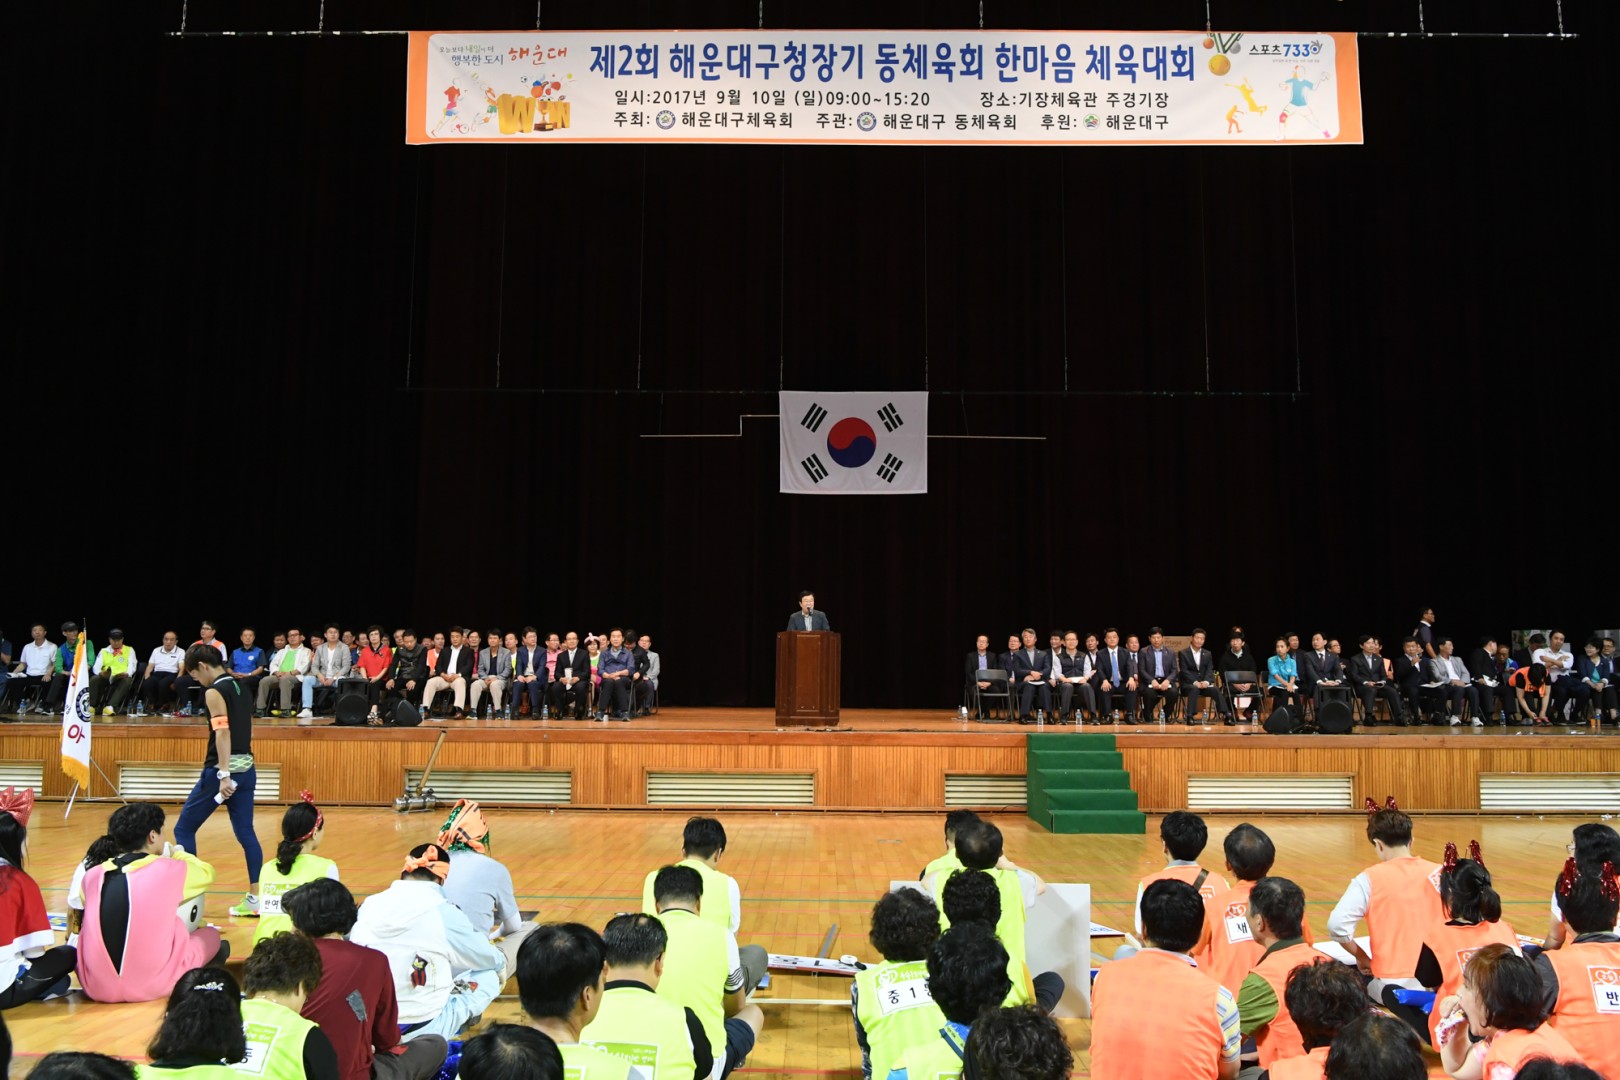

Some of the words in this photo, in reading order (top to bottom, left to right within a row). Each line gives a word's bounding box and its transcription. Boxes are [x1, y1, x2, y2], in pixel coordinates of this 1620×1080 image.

[451, 54, 480, 66] 행복한
[484, 54, 503, 65] 도시
[508, 44, 567, 66] 해운대
[590, 43, 659, 79] 제2회
[669, 41, 864, 83] 해운대구청장기
[875, 42, 984, 83] 동체육회
[995, 42, 1076, 83] 한마음
[1086, 43, 1195, 84] 체육대회
[615, 90, 706, 106] 일시:2017년
[717, 90, 741, 106] 9월
[752, 90, 785, 106] 10일
[980, 91, 1098, 108] 장소:기장체육관
[1106, 92, 1169, 108] 주경기장
[614, 111, 650, 128] 주최:
[682, 111, 792, 129] 해운대구체육회
[816, 113, 852, 129] 주관:
[883, 113, 946, 130] 해운대구
[954, 113, 1016, 131] 동체육회
[1041, 114, 1077, 130] 후원:
[1106, 114, 1169, 131] 해운대구
[264, 899, 282, 910] 반여
